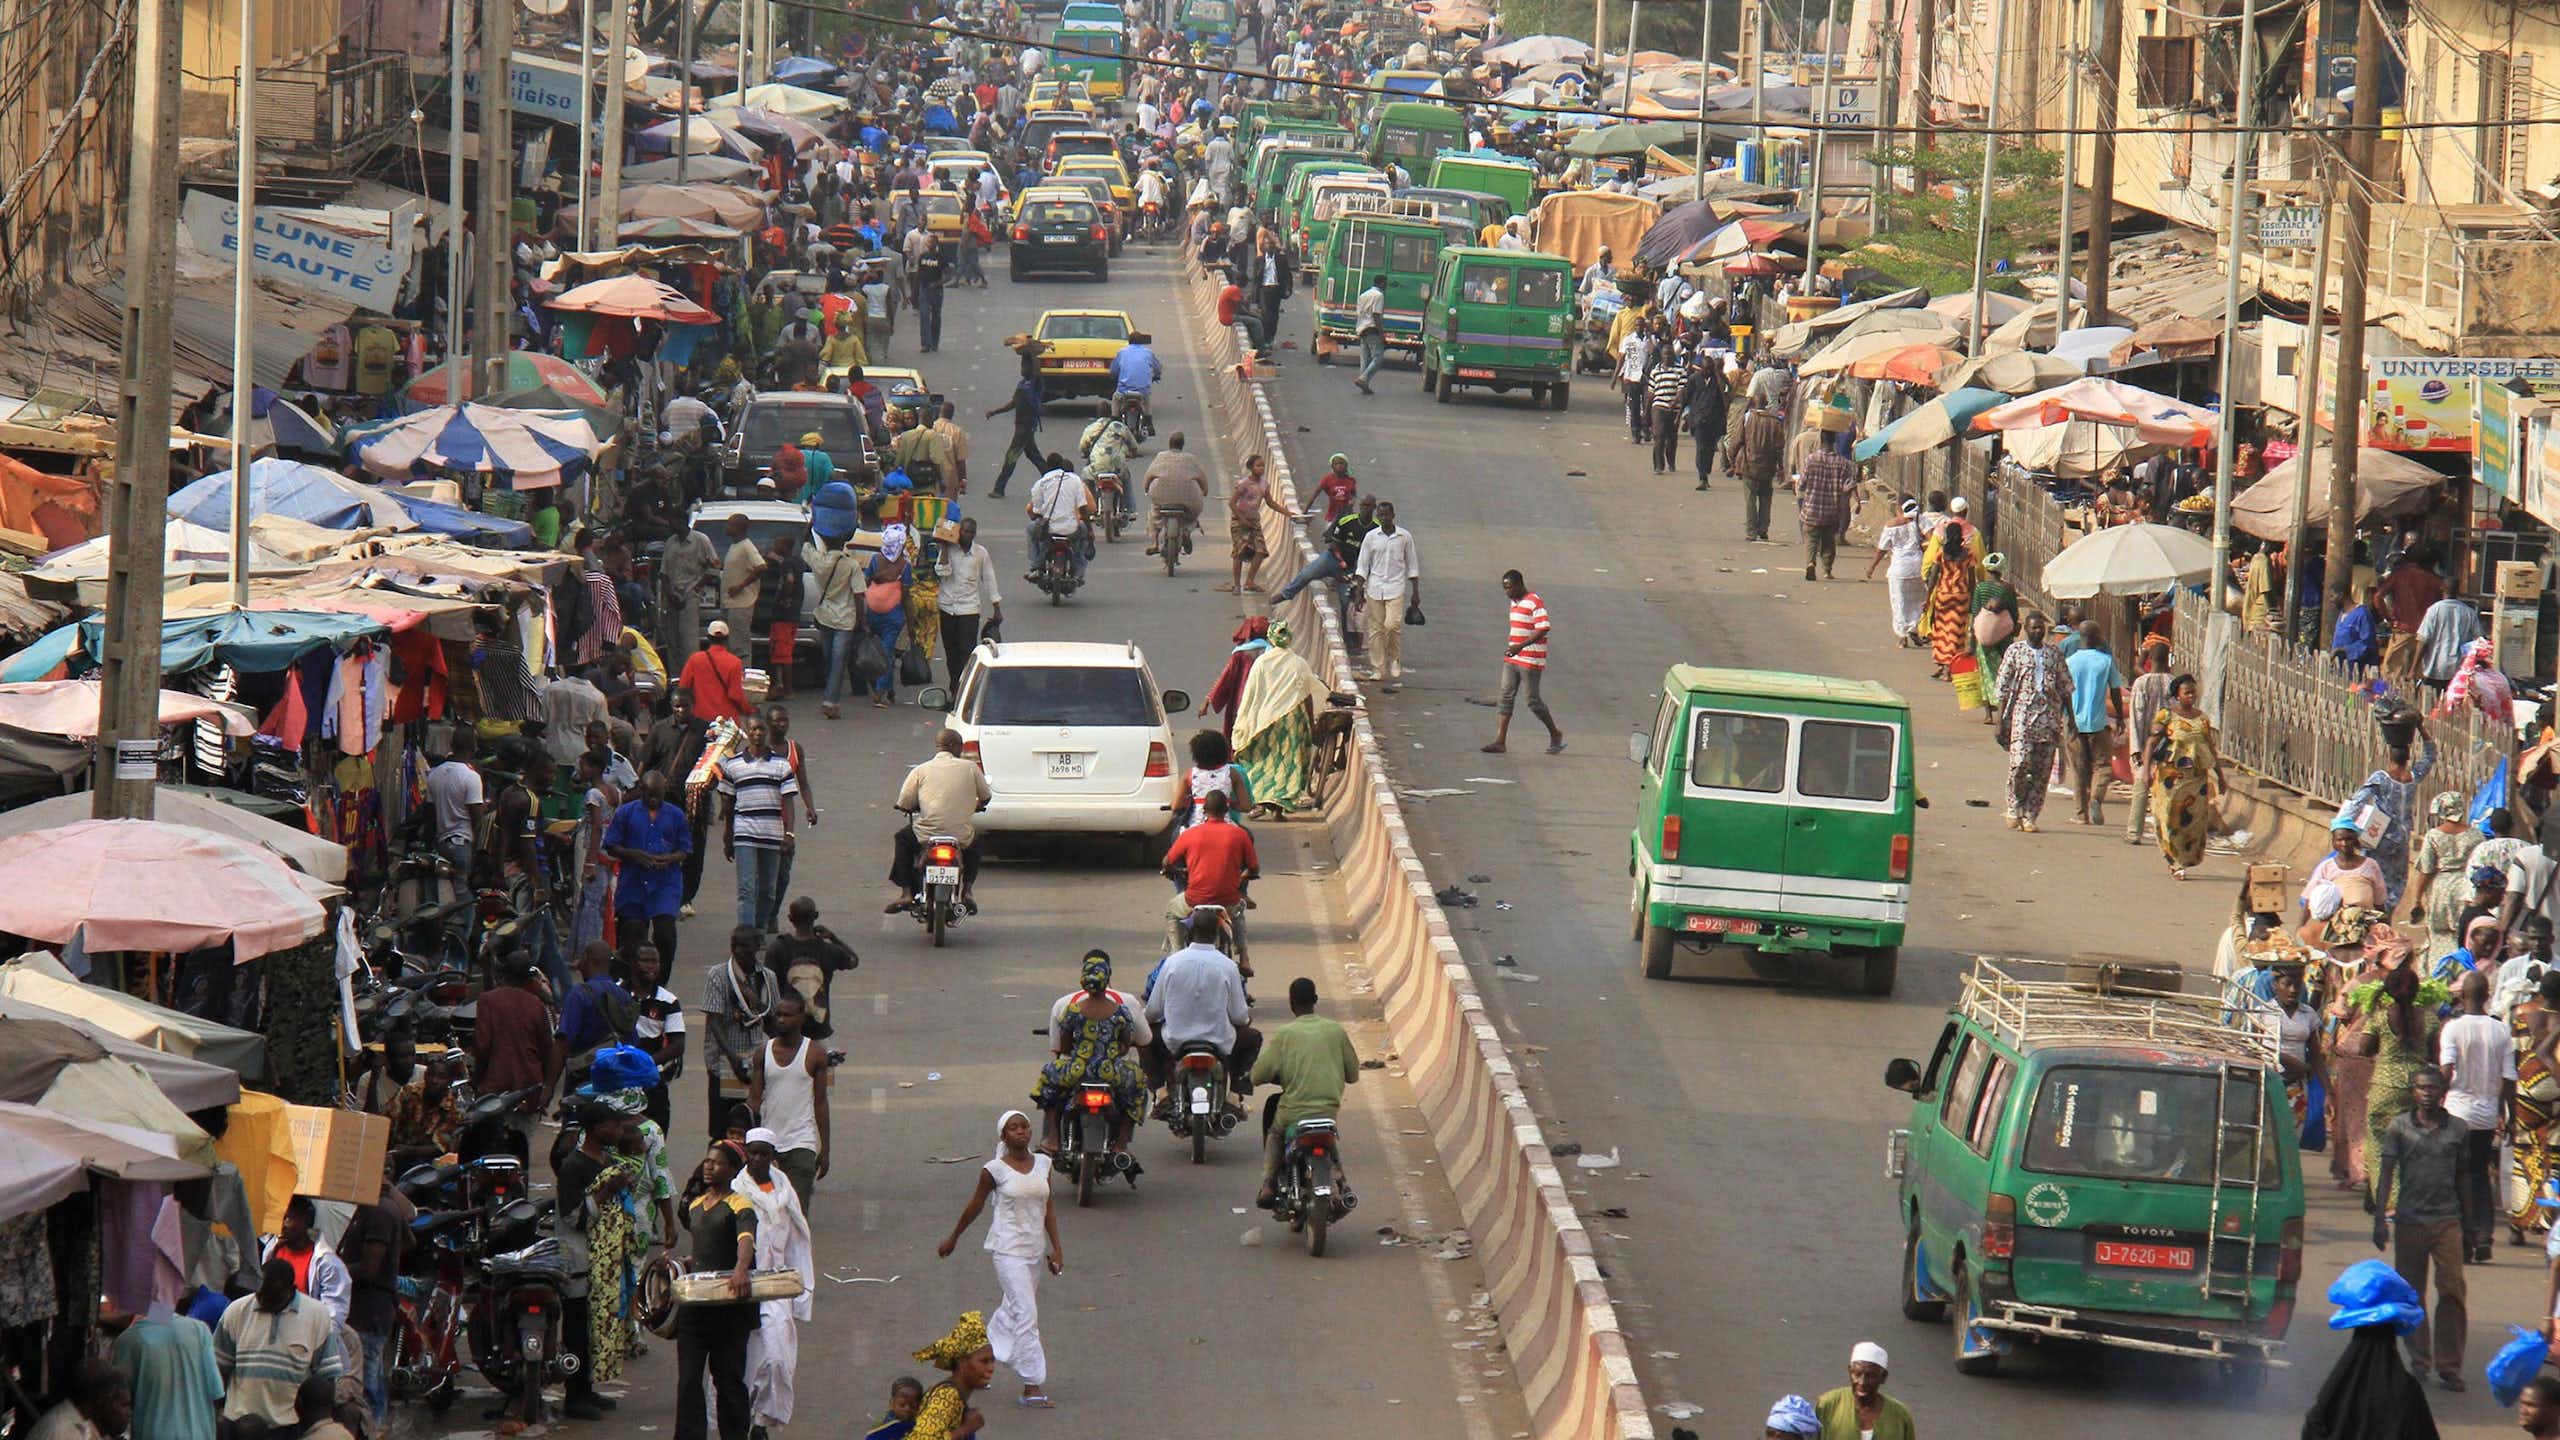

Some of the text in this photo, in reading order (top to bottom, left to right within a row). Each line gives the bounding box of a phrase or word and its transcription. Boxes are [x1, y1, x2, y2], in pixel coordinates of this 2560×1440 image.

[2279, 206, 2313, 223] ATM
[255, 216, 356, 259] LUNE
[2261, 230, 2310, 238] TRANSIT ET
[221, 234, 374, 292] BEAUTE
[2381, 360, 2555, 378] UNIVERSELLE
[1059, 754, 1072, 765] AB
[1051, 765, 1082, 773] 3696 MD
[2121, 1225, 2176, 1238] TOYOTA
